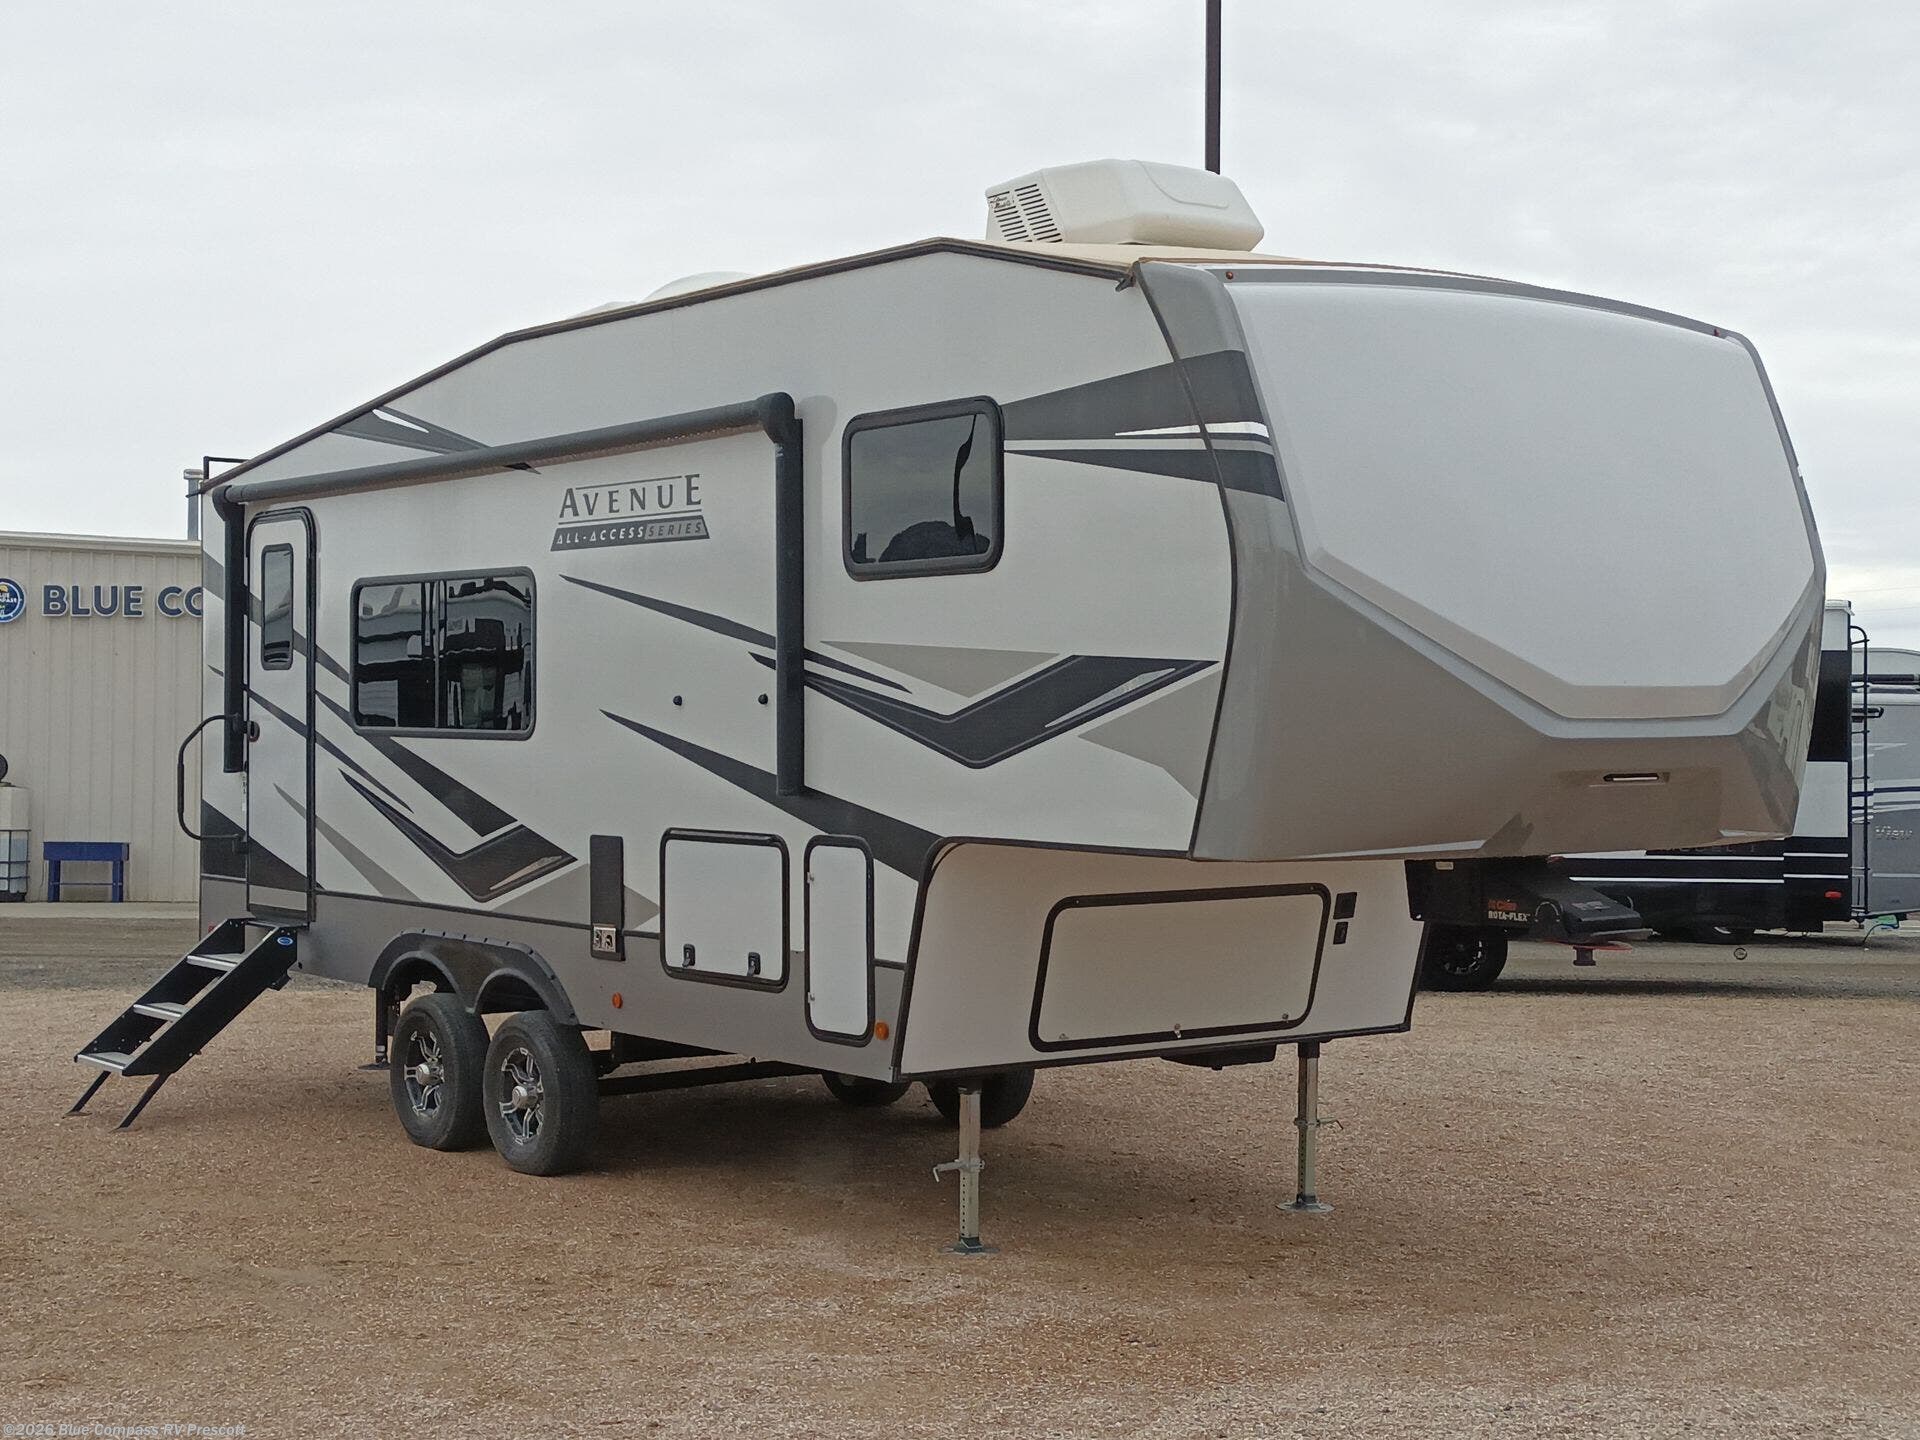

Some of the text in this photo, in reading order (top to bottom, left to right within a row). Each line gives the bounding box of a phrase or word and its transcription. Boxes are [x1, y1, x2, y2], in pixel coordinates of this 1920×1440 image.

[559, 474, 702, 518] AVENUE
[556, 522, 702, 545] ALL-ACCESS SERIES
[42, 584, 143, 616] BLUE
